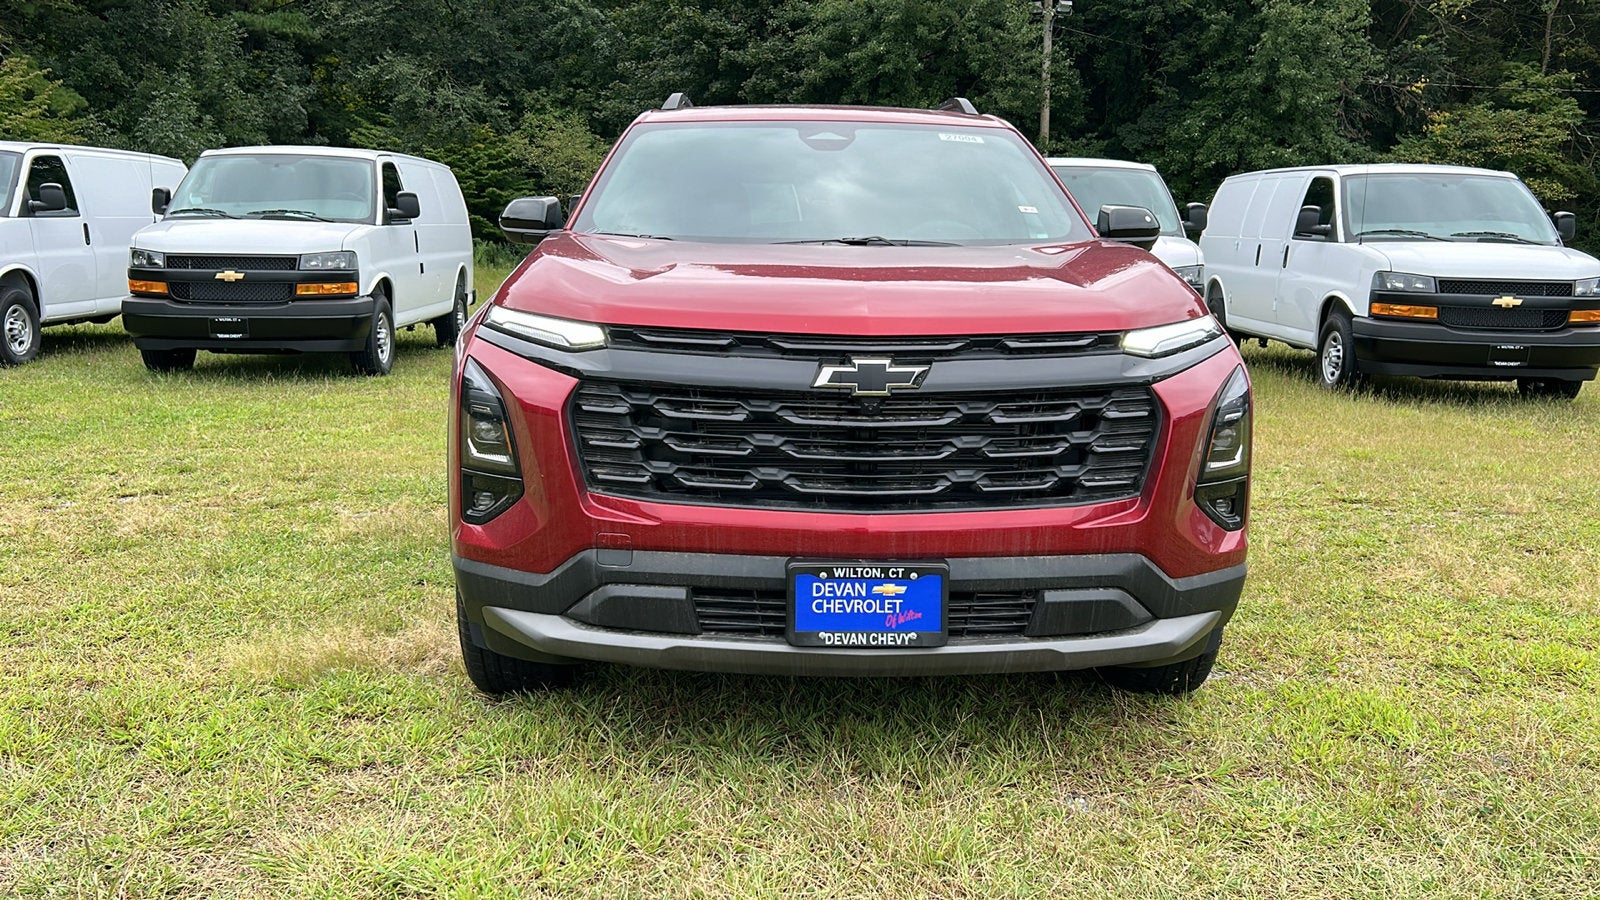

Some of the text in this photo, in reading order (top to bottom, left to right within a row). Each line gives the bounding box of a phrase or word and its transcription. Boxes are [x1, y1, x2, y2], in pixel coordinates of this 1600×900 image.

[833, 568, 905, 579] WILTON, CT
[812, 582, 866, 597] DEVAN
[811, 599, 903, 614] CHEVROLET
[885, 609, 923, 629] Of Wilton
[824, 632, 911, 645] DEVAN CHEVY
